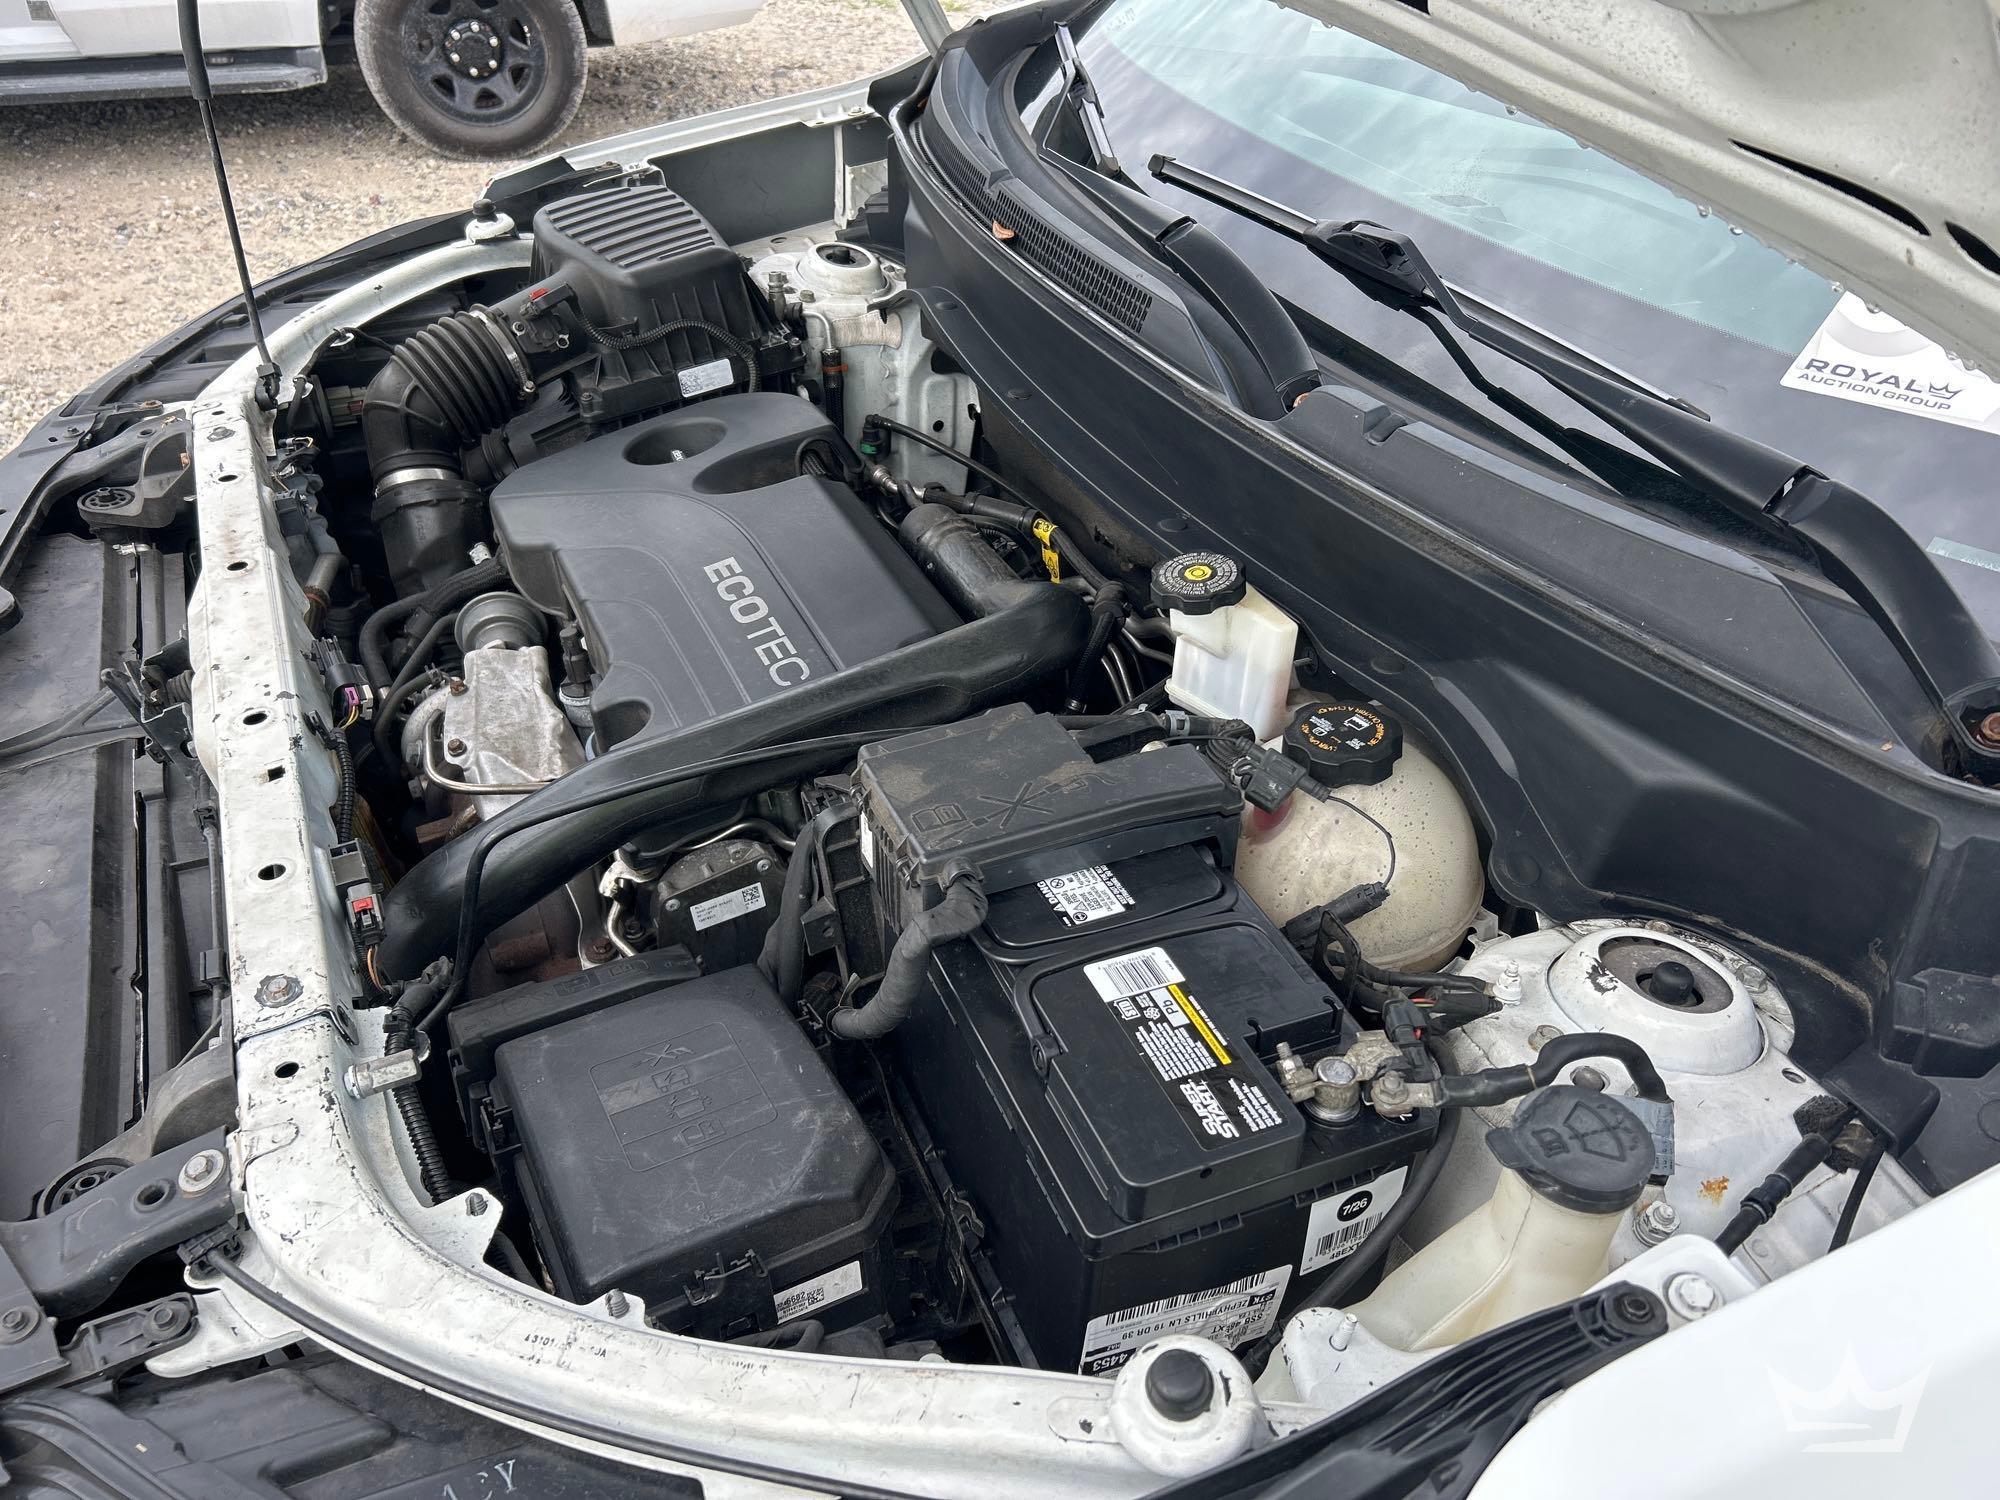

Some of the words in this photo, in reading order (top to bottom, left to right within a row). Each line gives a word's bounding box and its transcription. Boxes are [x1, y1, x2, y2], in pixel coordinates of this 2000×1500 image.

[1804, 358, 1923, 394] ROYAL
[1797, 373, 1880, 396] AUCTION
[1882, 391, 1952, 410] GROUP
[703, 556, 811, 688] ECOTEC
[1162, 999, 1179, 1015] Pb
[1179, 1082, 1219, 1136] SUPER
[1190, 1078, 1241, 1140] START
[1342, 1197, 1368, 1216] 7/26
[1136, 1326, 1151, 1337] DR
[1153, 1323, 1166, 1332] 19
[1168, 1319, 1182, 1328] LN
[1121, 1331, 1134, 1341] 39
[1092, 1353, 1128, 1372] 4453
